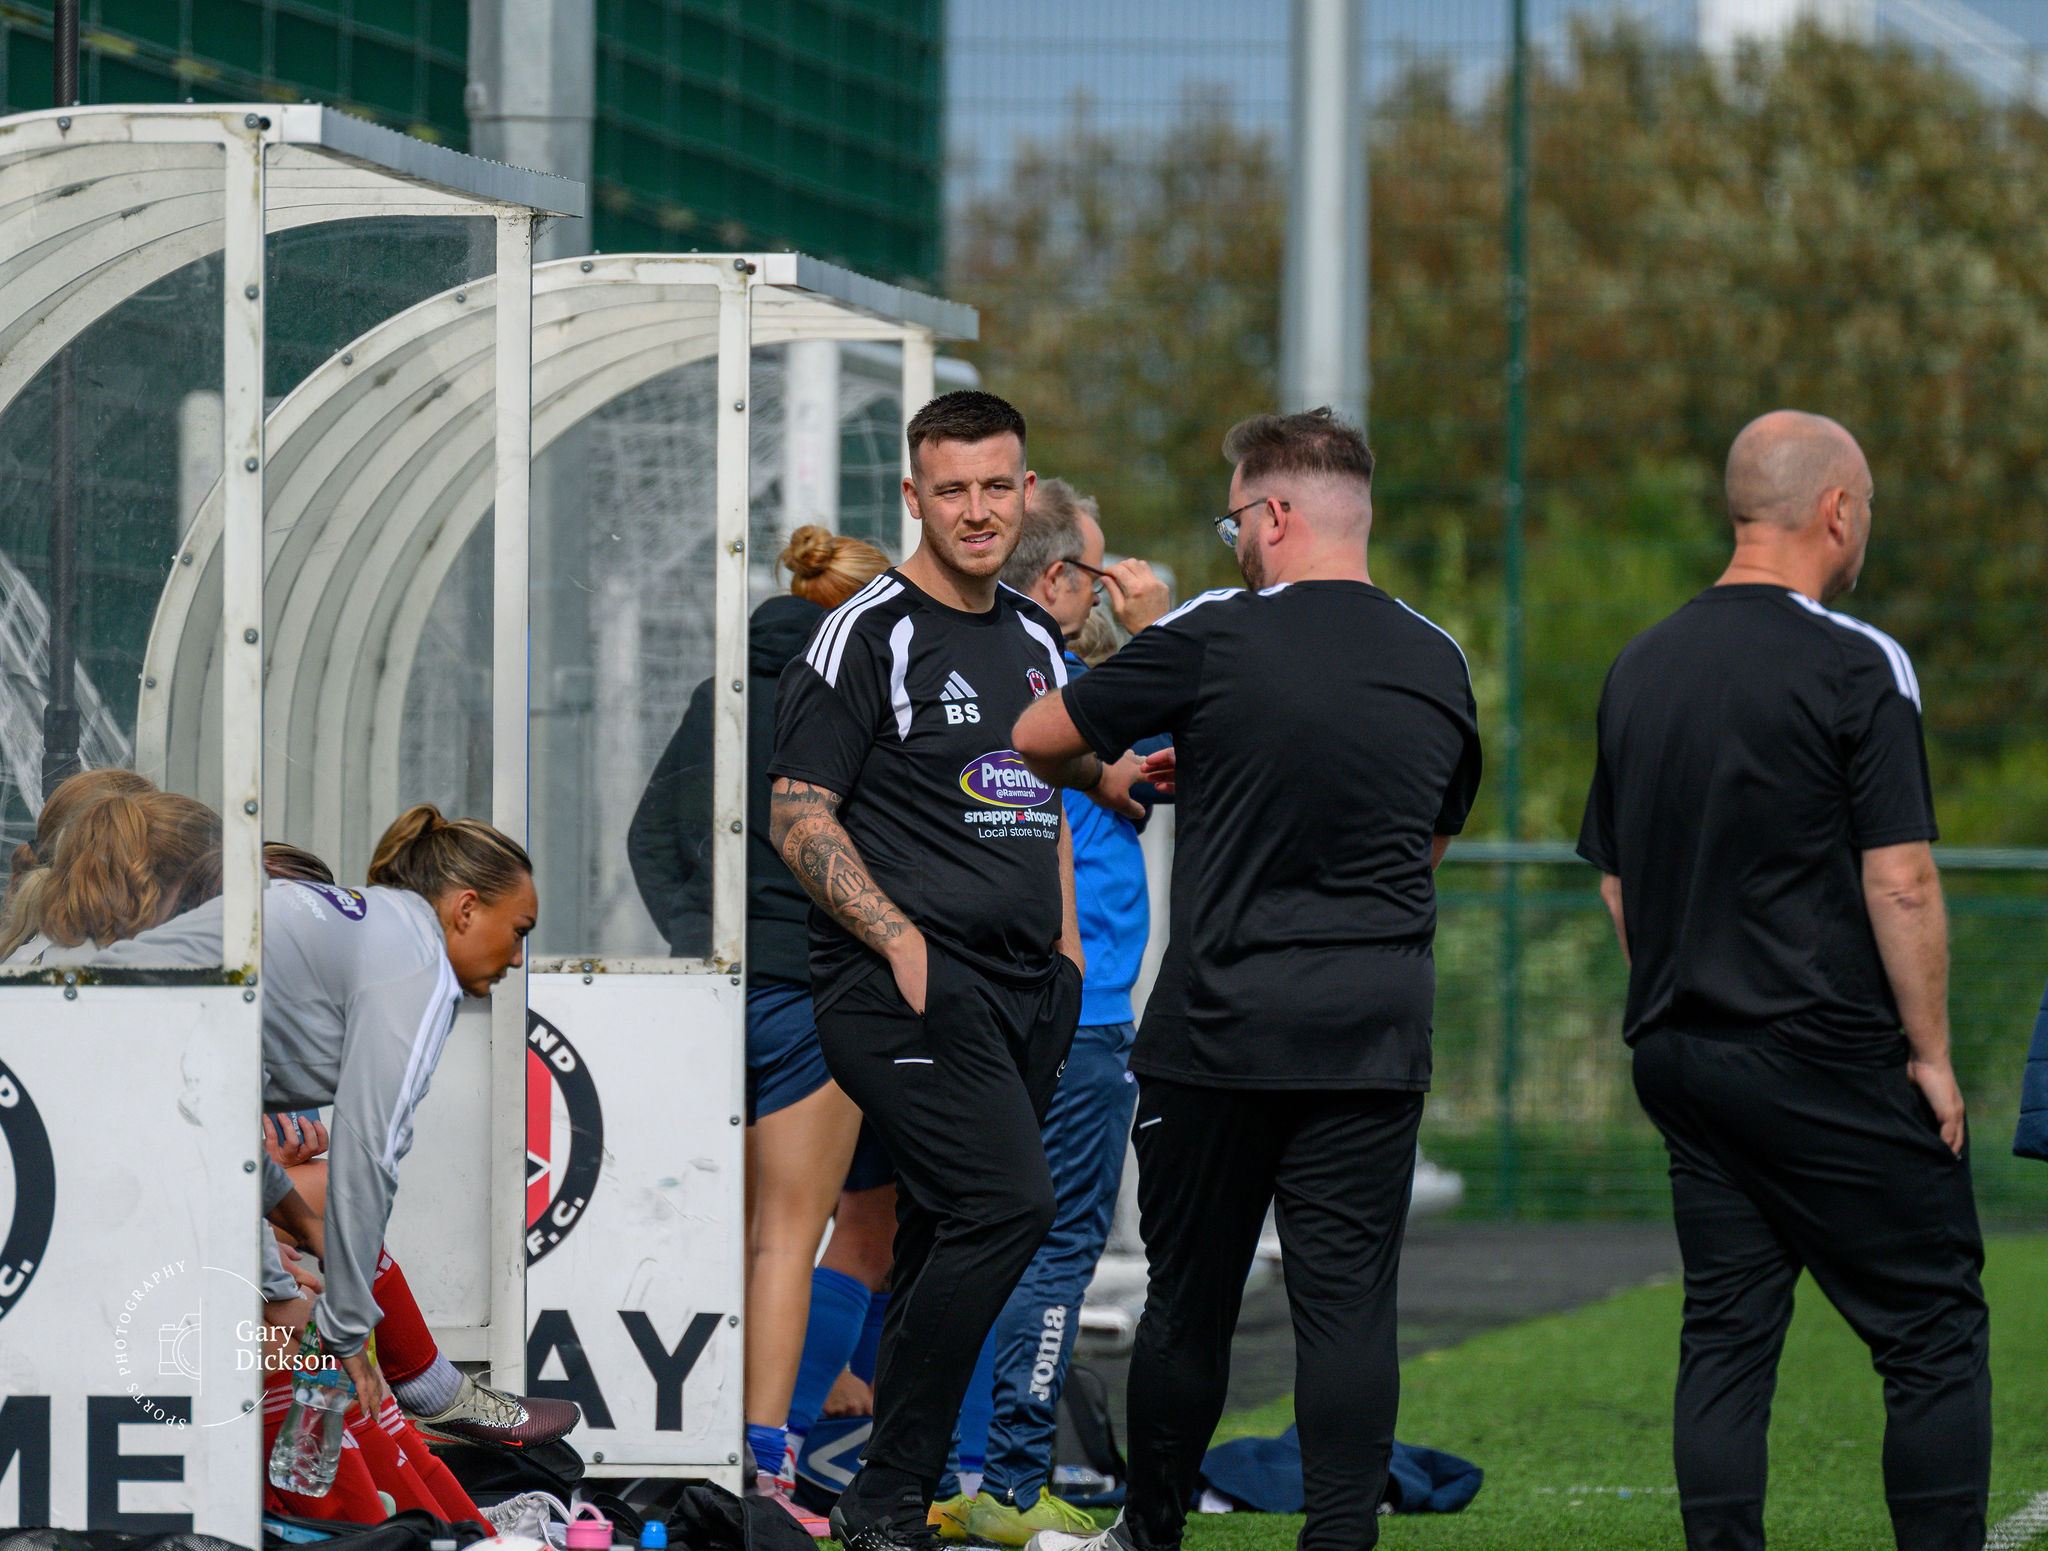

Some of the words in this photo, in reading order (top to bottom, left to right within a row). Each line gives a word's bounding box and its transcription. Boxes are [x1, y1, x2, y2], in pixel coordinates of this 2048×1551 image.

[944, 703, 981, 725] BS
[996, 789, 1036, 799] @Rawmarsh
[964, 810, 1017, 825] snappy
[1024, 808, 1059, 827] shopper
[978, 826, 1008, 839] Local
[1010, 827, 1032, 838] store
[1033, 828, 1042, 838] to
[1043, 828, 1056, 840] door
[1029, 1305, 1067, 1401] joma
